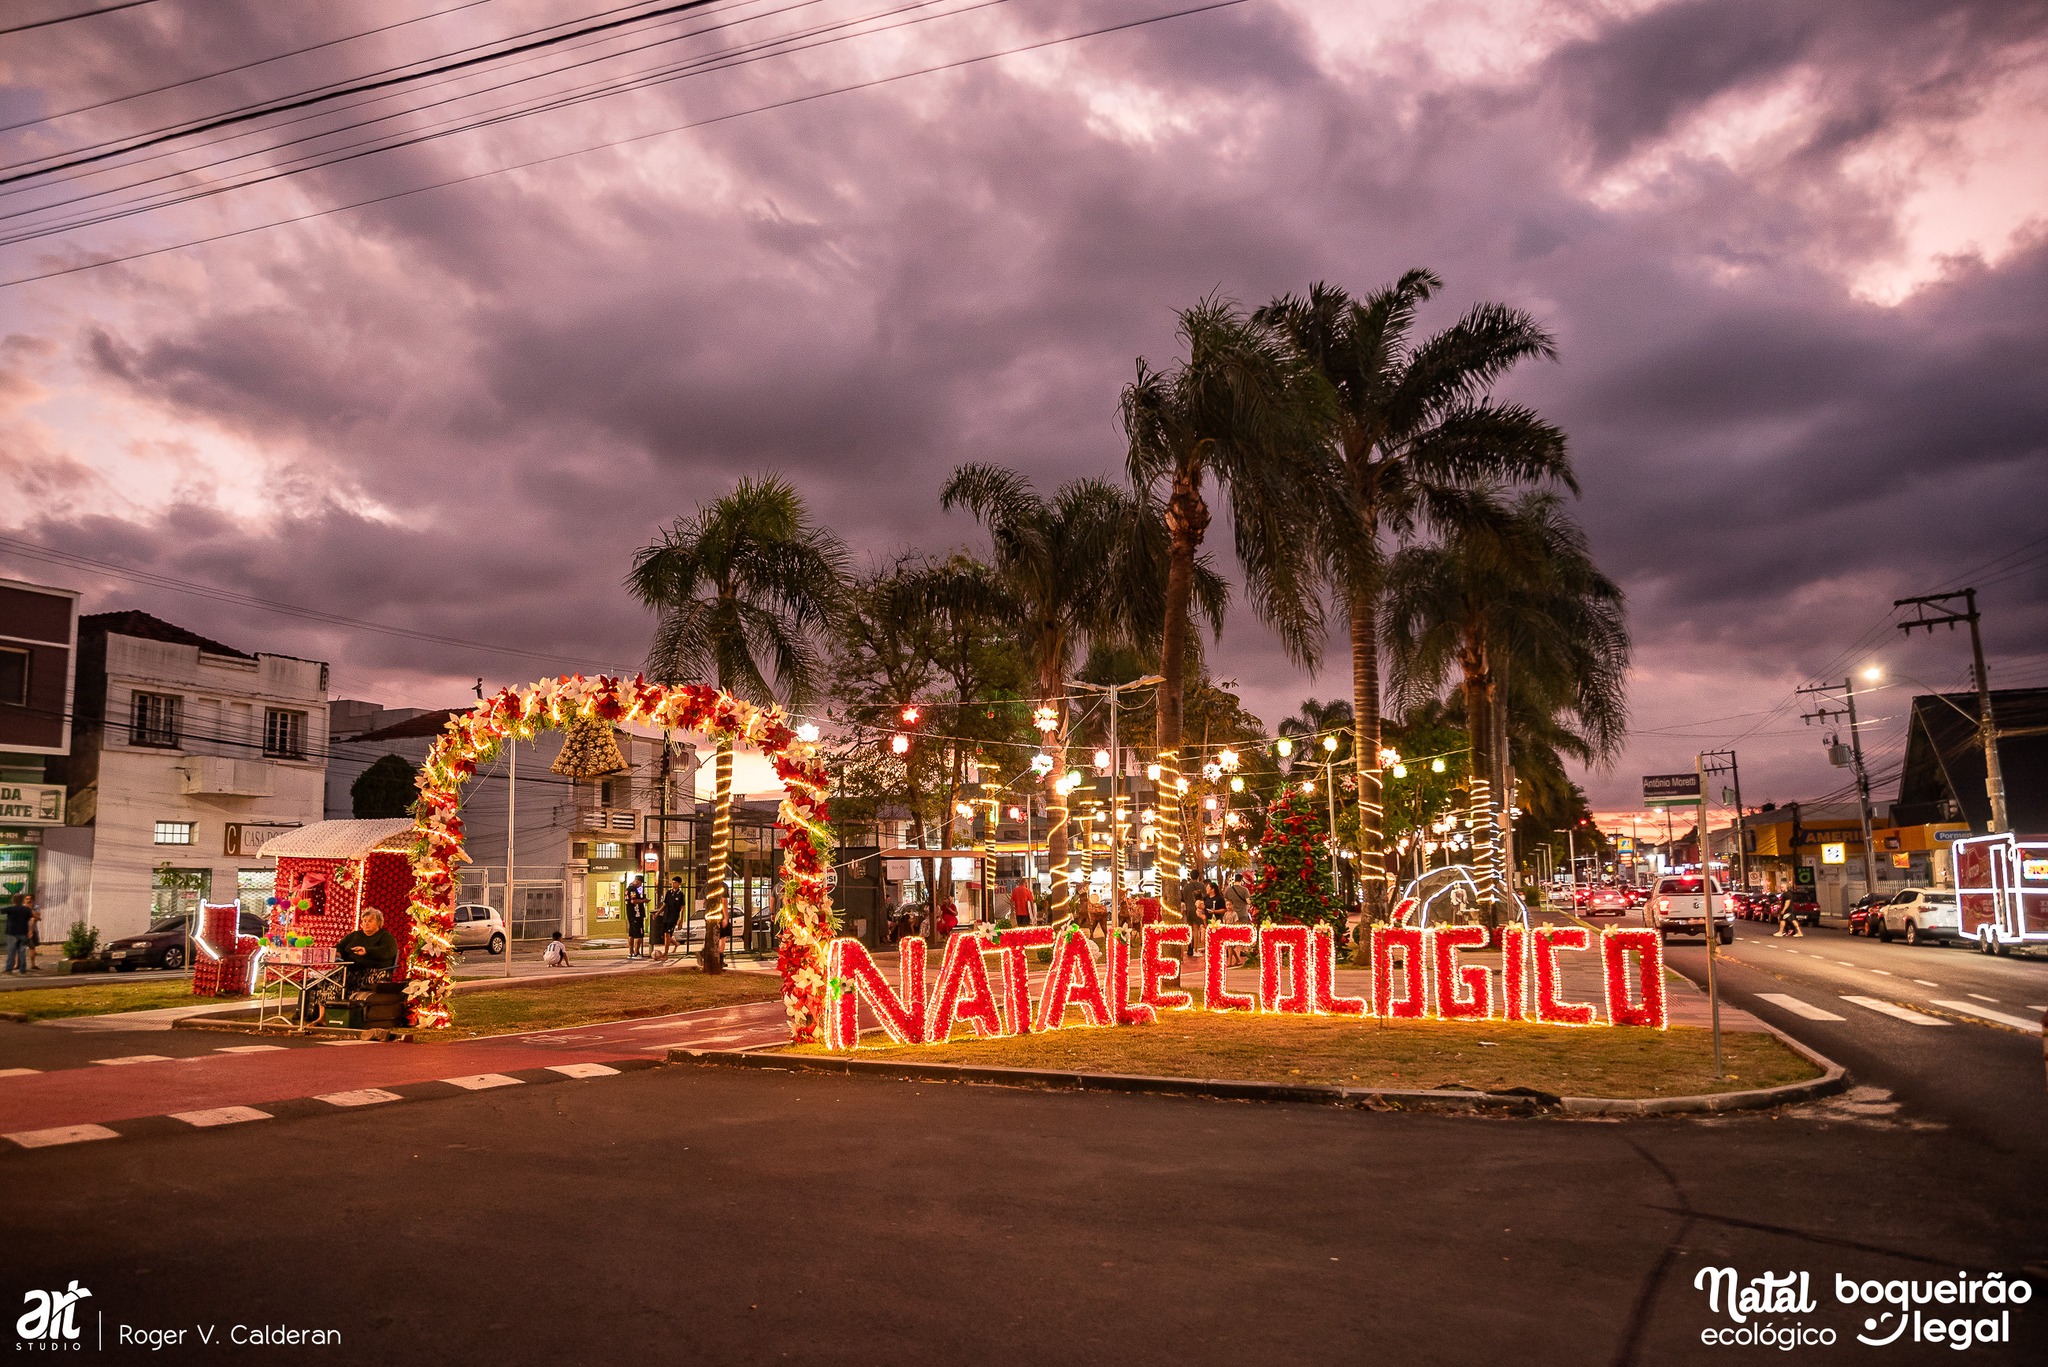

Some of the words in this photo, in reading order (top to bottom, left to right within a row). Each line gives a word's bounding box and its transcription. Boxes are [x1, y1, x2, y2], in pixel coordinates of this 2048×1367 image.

[1671, 777, 1696, 787] Moretti
[227, 825, 237, 855] C
[825, 922, 1156, 1050] NATAL
